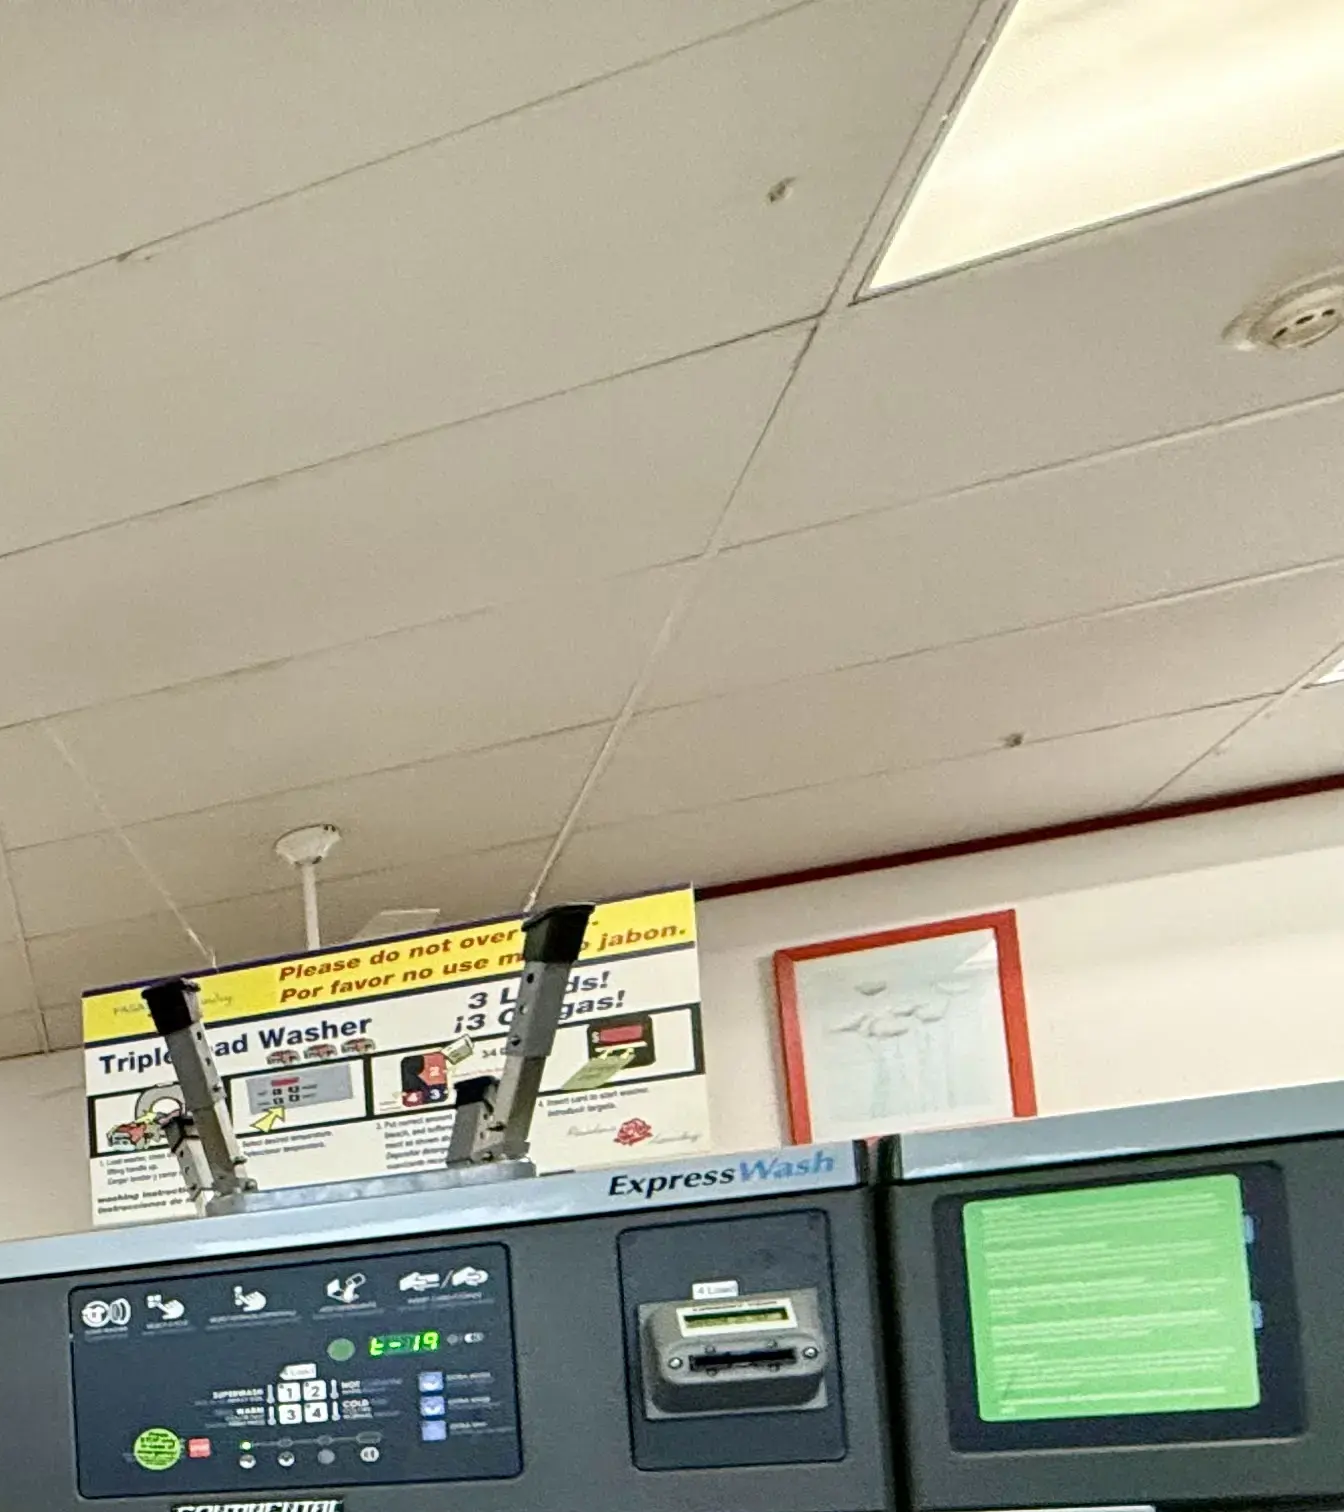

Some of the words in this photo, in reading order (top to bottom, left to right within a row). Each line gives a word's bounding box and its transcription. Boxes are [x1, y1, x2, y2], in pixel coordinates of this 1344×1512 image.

[279, 955, 361, 982] Please
[370, 947, 400, 967] do
[410, 935, 452, 957] not
[460, 929, 518, 950] over
[280, 985, 324, 1004] Por
[330, 972, 393, 996] favor
[402, 967, 433, 982] no
[442, 959, 490, 975] use
[598, 924, 687, 953] jabon.
[468, 992, 489, 1010] 3
[259, 1017, 373, 1051] Washer
[286, 1387, 293, 1399] 1
[311, 1386, 321, 1398] 2
[287, 1409, 296, 1420] 3
[312, 1407, 322, 1419] 4
